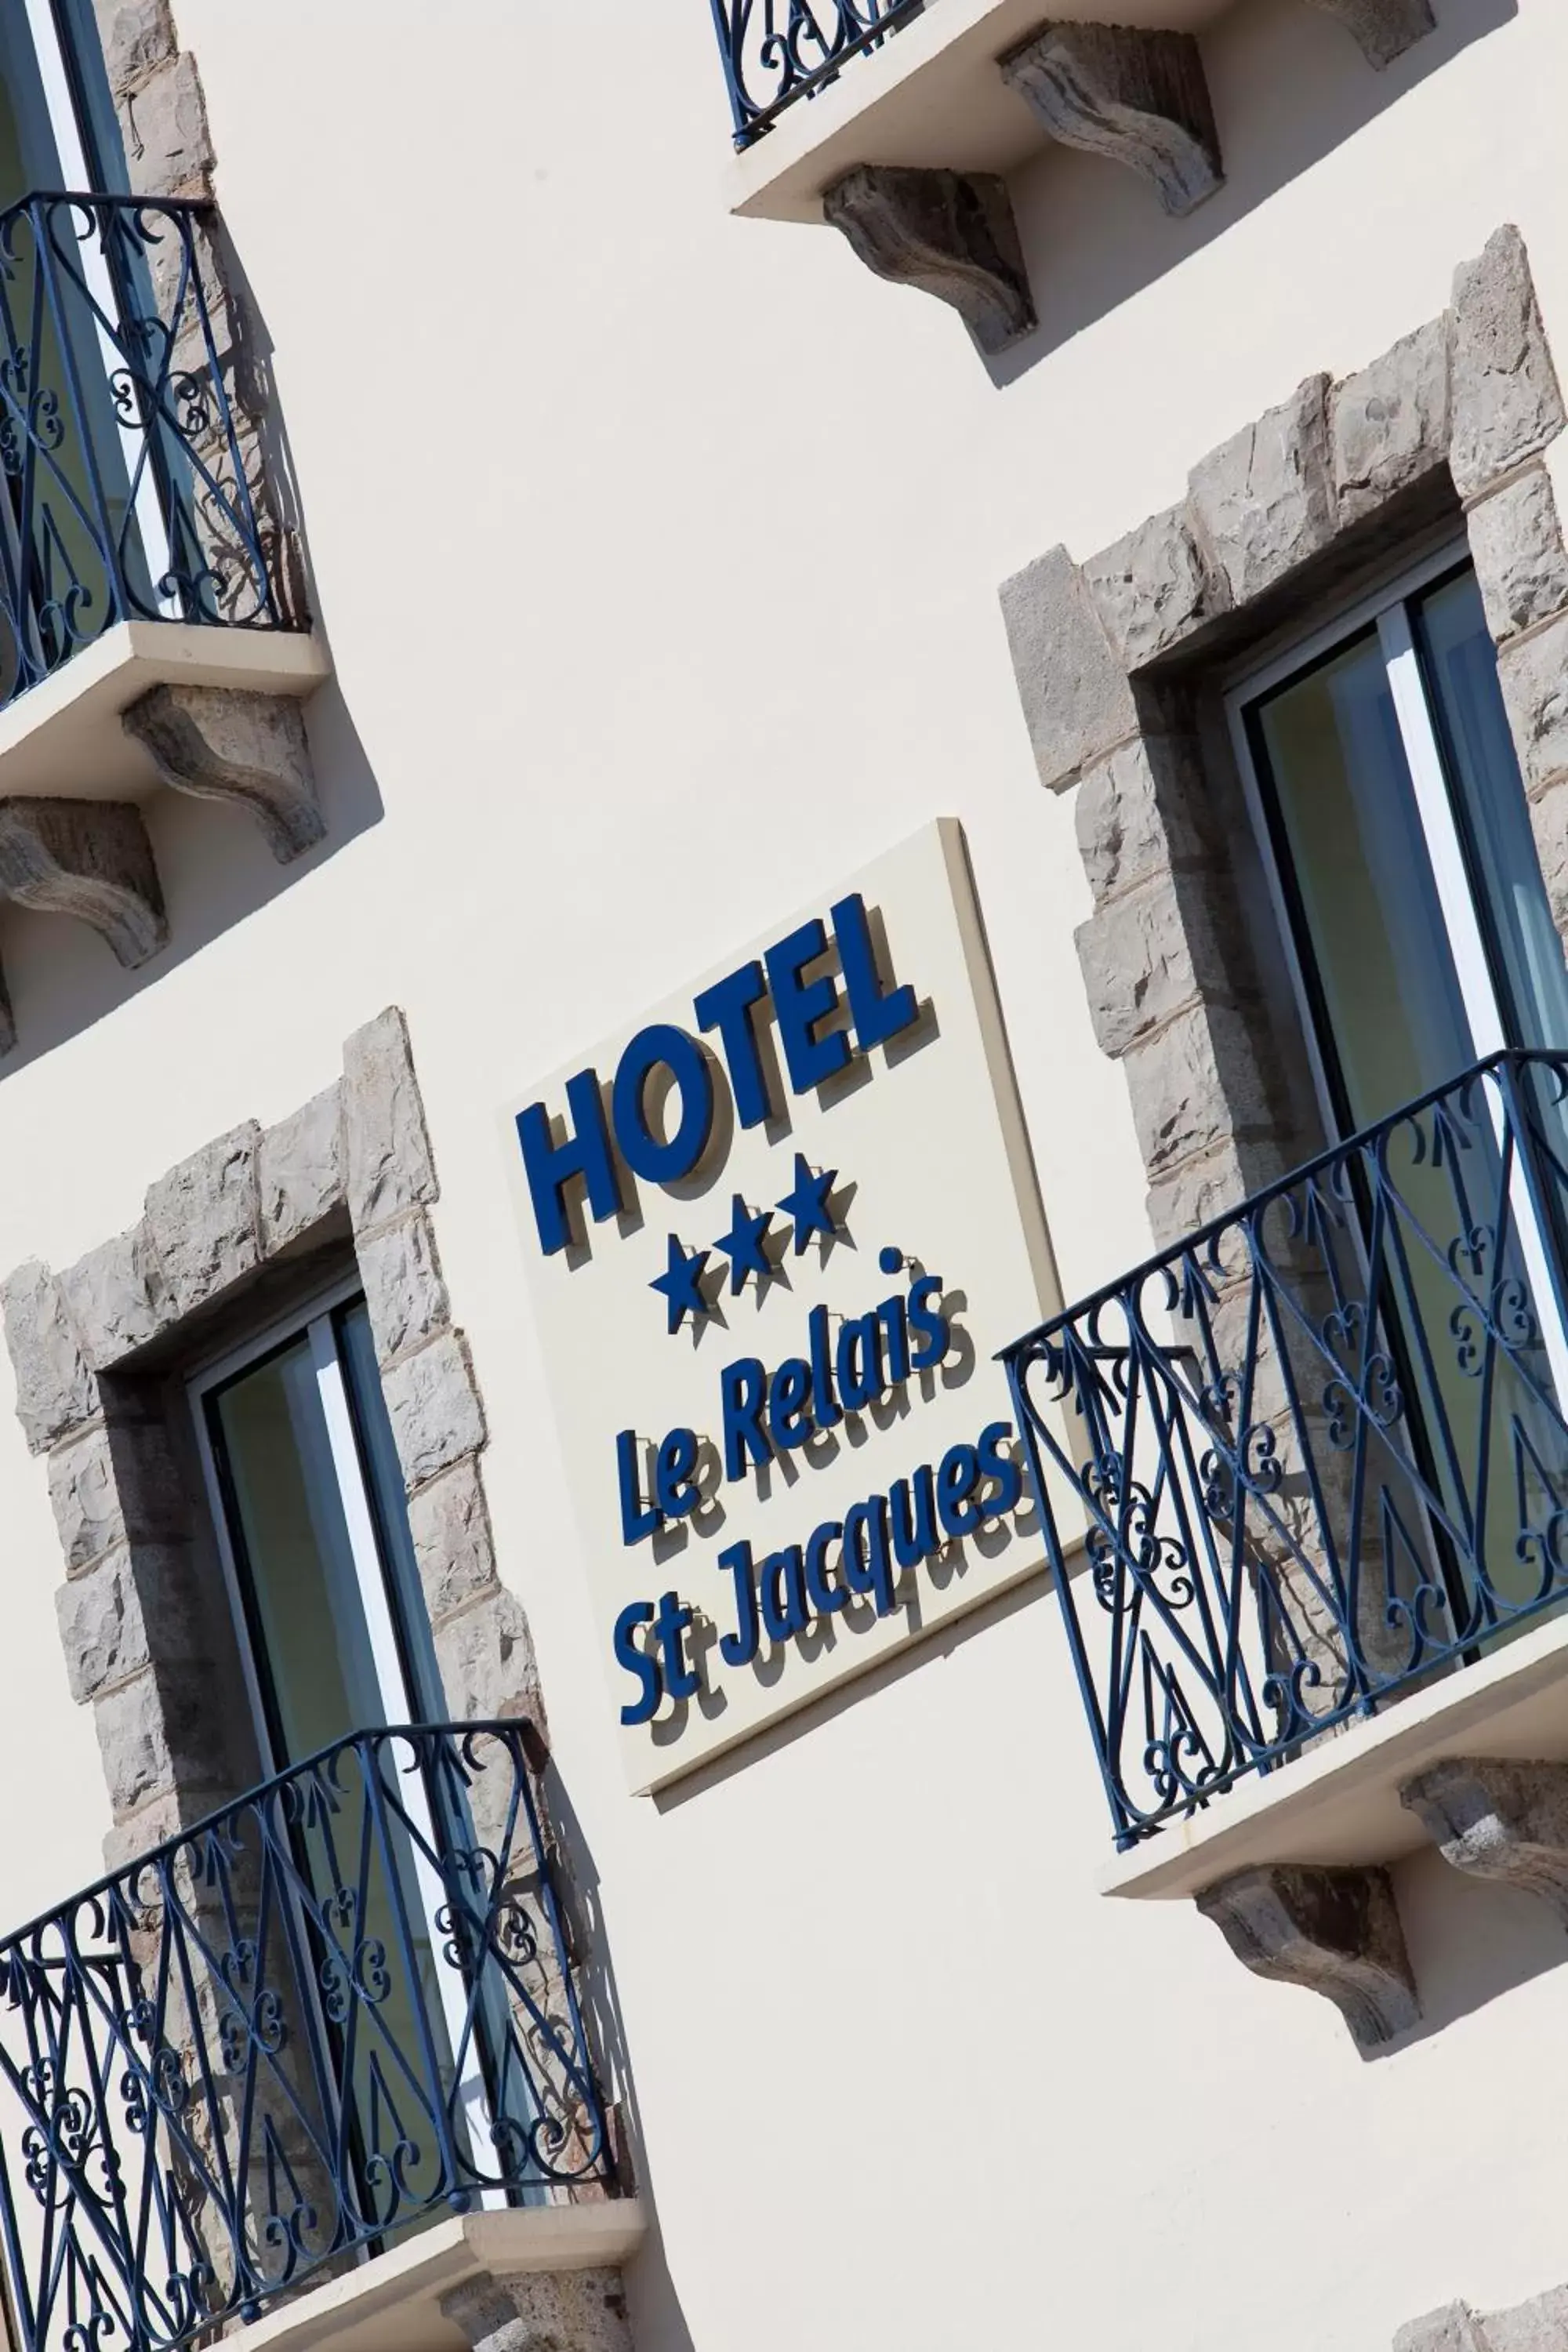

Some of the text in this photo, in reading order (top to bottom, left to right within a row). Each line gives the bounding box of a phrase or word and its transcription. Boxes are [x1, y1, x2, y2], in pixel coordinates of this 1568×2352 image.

[515, 893, 919, 1256] HOTEL
[616, 1247, 950, 1546] Le Relais
[613, 1421, 1023, 1726] St Jacques
